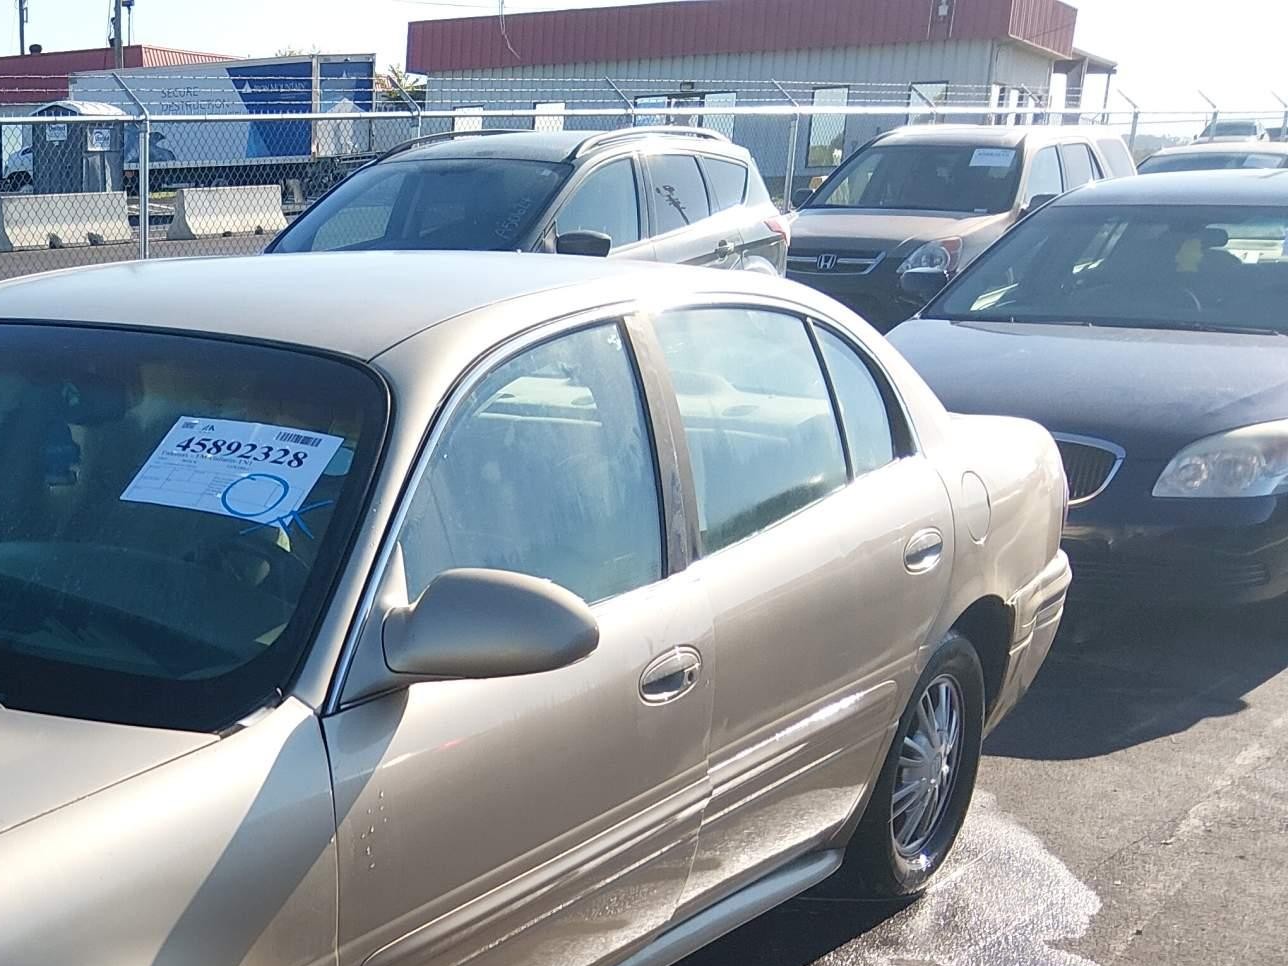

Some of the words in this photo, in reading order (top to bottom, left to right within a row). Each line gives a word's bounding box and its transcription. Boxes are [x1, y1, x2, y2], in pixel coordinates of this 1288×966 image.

[161, 86, 199, 98] SECURE
[161, 98, 230, 112] DESTRUCTION
[176, 436, 309, 468] 45892328
